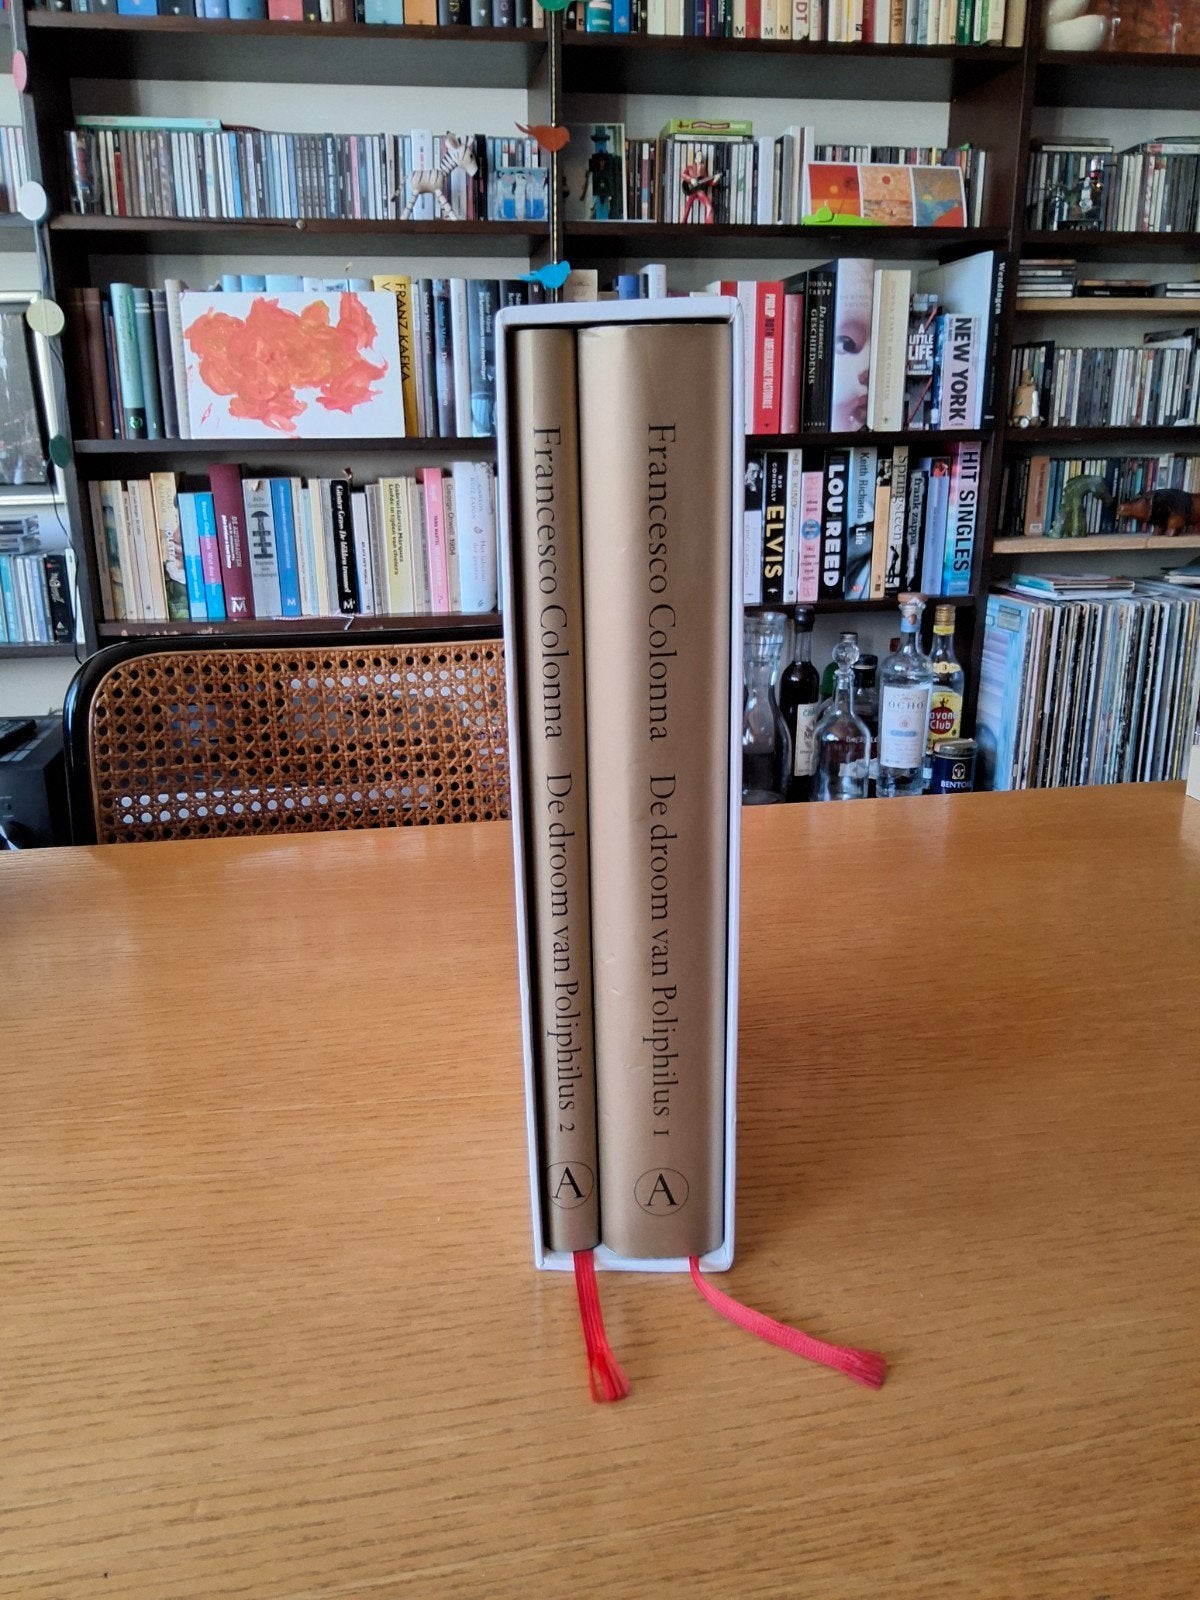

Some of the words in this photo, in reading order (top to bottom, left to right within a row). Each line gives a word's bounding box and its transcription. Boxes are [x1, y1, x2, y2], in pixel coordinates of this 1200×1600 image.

[395, 283, 409, 330] FRANZ
[765, 294, 776, 318] PHILIP
[995, 262, 1006, 315] Wendingen
[764, 318, 775, 337] ROTH
[808, 308, 818, 385] GESCHIEDENIS
[909, 334, 934, 344] LITTLE
[953, 318, 972, 362] NEW
[398, 335, 411, 382] KAFKA
[763, 338, 774, 378] AMERIKAANSE
[908, 345, 934, 360] LIFE
[762, 378, 774, 410] PASTORALE
[949, 368, 969, 421] YORK
[770, 462, 778, 501] CONNOLLY
[860, 452, 870, 477] Keith
[961, 451, 978, 482] HIT
[336, 486, 344, 510] Günter
[826, 464, 844, 513] LOU
[858, 480, 868, 518] Richards
[892, 456, 908, 540] Springsteen
[912, 478, 922, 510] frank
[338, 511, 346, 530] Grass
[390, 506, 396, 514] in
[533, 426, 562, 595] Francesco
[648, 422, 676, 594] Francesco
[203, 522, 212, 549] Chatwin
[338, 530, 348, 541] De
[764, 506, 784, 578] ELVIS
[856, 527, 866, 545] Life
[909, 512, 919, 546] zappa
[953, 490, 974, 572] SINGLES
[340, 541, 349, 565] blikken
[392, 550, 400, 575] cholera
[823, 521, 842, 586] REED
[342, 566, 352, 593] trommel
[232, 600, 248, 612] M
[288, 598, 297, 606] M
[540, 604, 569, 740] Colonna
[648, 604, 678, 742] Colonna
[888, 701, 924, 710] OCHO
[930, 720, 951, 730] Club
[547, 772, 574, 814] De
[650, 774, 676, 816] De
[549, 822, 575, 918] droom
[651, 825, 678, 922] droom
[553, 925, 571, 974] van
[652, 929, 669, 978] van
[547, 980, 583, 1110] Poliphilus
[642, 985, 679, 1116] Poliphilus
[560, 1123, 575, 1132] 2
[552, 1166, 586, 1198] A
[644, 1172, 680, 1206] A
